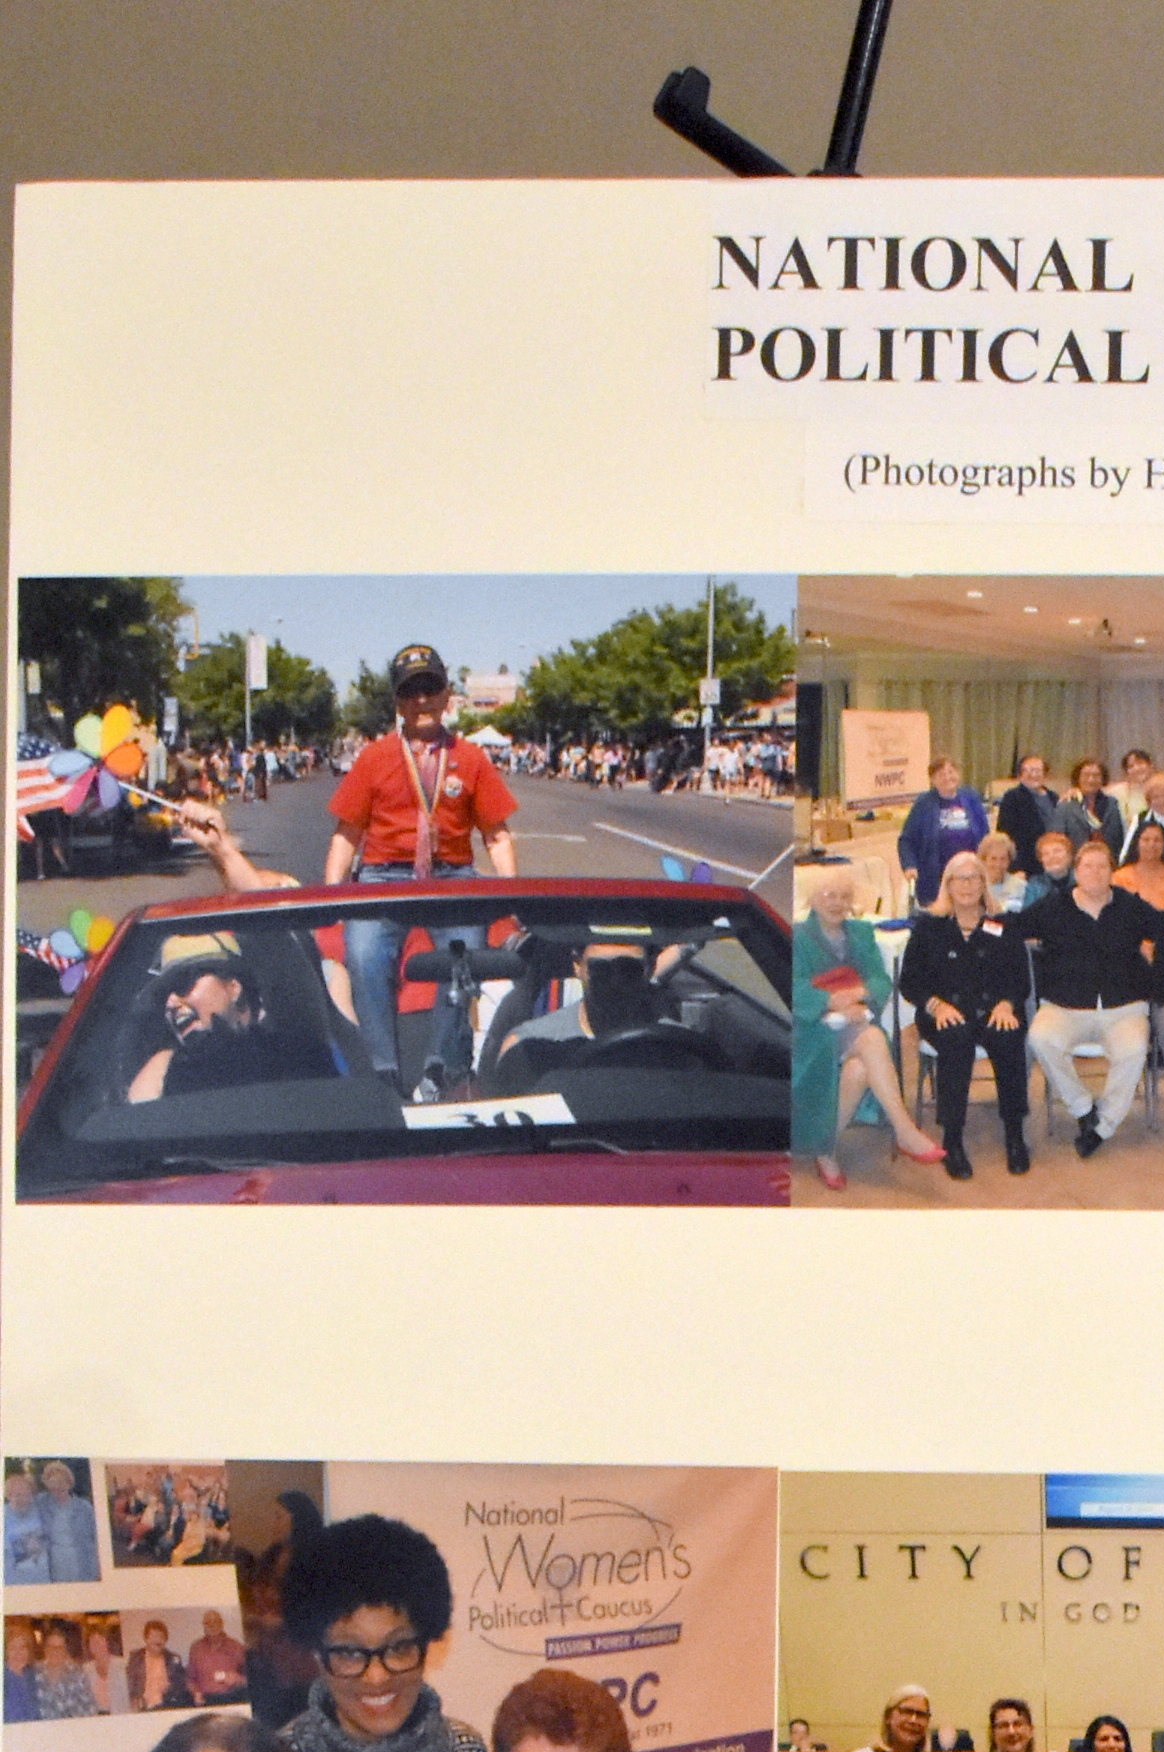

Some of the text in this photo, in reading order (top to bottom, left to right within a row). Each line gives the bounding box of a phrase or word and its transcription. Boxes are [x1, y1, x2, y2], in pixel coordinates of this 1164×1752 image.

[711, 235, 1135, 292] NATIONAL
[711, 326, 1151, 384] POLITICAL
[844, 453, 1076, 496] (Photographs
[1088, 455, 1131, 498] by
[465, 1496, 565, 1526] National
[483, 1532, 692, 1593] Women's
[799, 1544, 982, 1581] CITY
[1057, 1545, 1142, 1581] OF
[468, 1596, 654, 1631] Political Caucus
[1001, 1601, 1038, 1623] IN
[1063, 1602, 1140, 1625] GOD
